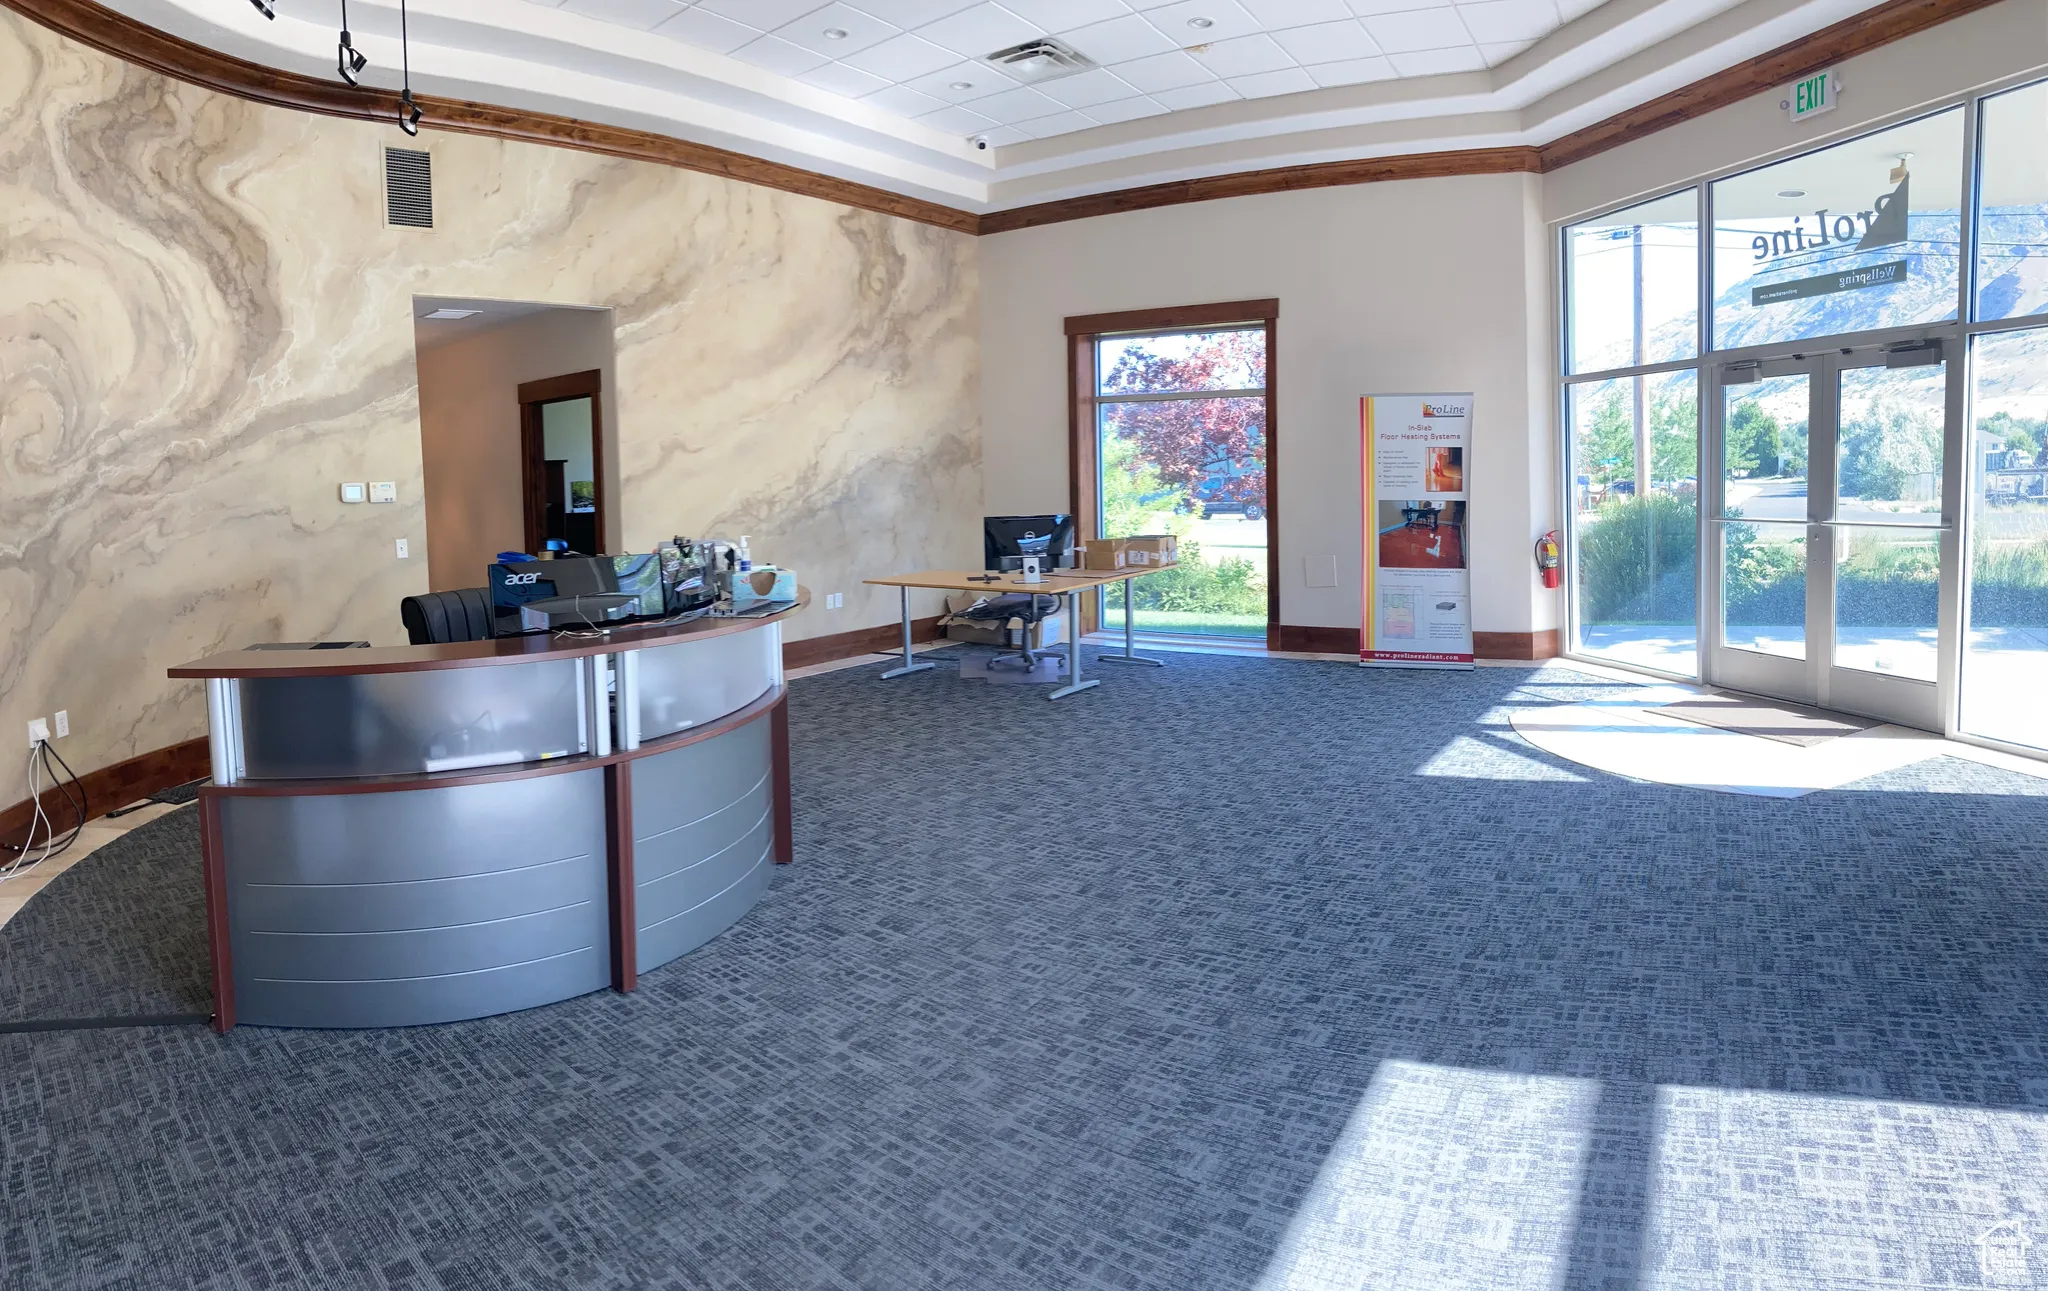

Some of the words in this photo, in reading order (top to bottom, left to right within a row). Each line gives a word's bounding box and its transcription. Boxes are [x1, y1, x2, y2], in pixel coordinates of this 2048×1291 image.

[1796, 73, 1827, 114] EXIT
[1424, 403, 1465, 414] ProLine
[1400, 433, 1428, 442] Heating
[1430, 433, 1461, 442] Systems
[504, 572, 542, 586] acer
[1373, 652, 1459, 661] www.prolineradiant.com
